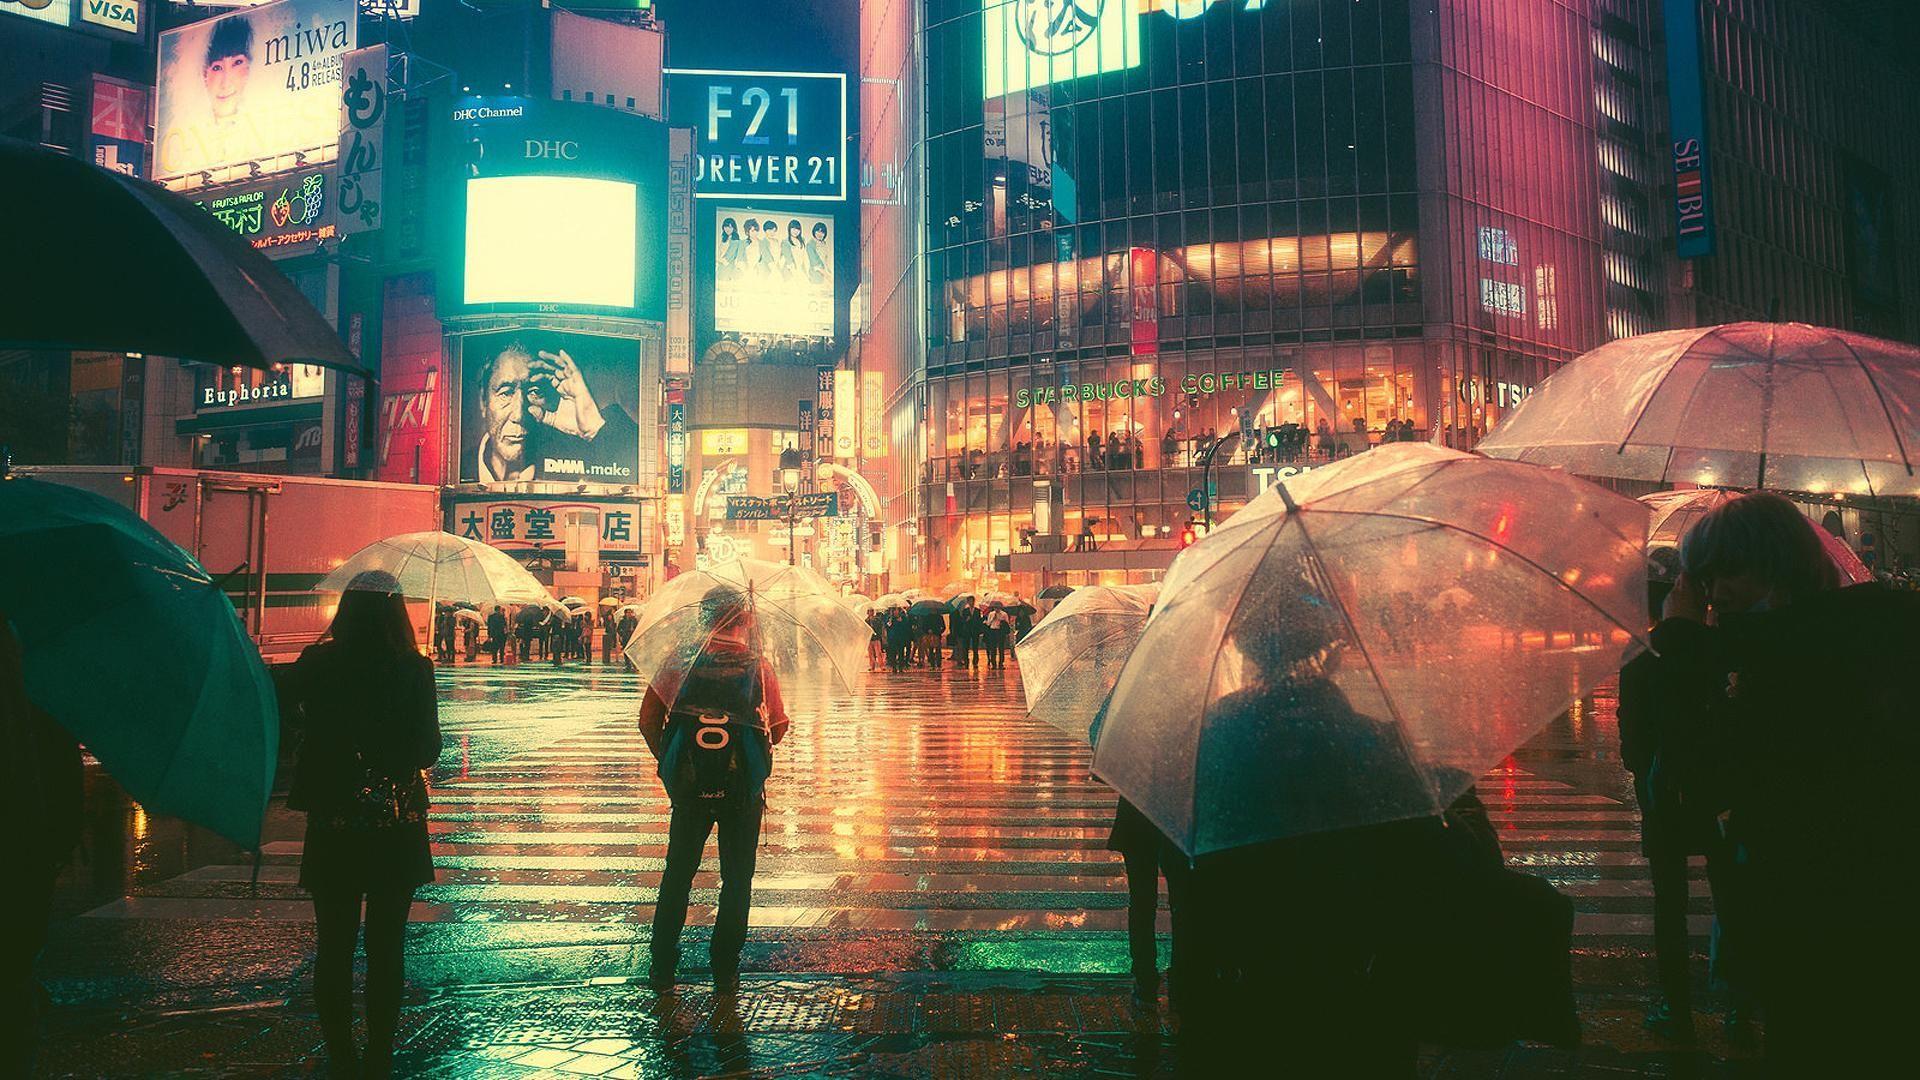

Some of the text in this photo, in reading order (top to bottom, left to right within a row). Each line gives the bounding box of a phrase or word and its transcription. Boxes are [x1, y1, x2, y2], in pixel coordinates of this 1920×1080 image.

[89, 0, 136, 24] VISA
[265, 20, 348, 66] miwa
[286, 62, 310, 91] 4.8
[322, 53, 344, 69] ALBU
[312, 67, 342, 87] RELEAS
[454, 106, 523, 120] DHC Channel
[708, 86, 798, 145] F21
[341, 66, 384, 227] もんじゃ
[525, 140, 578, 160] DHC
[808, 156, 835, 184] 21
[1674, 138, 1704, 234] SEIBU
[539, 304, 559, 312] DHC
[204, 380, 288, 407] Euphoria
[1016, 370, 1284, 408] STARBUCKS COFFEE
[819, 370, 833, 457] 洋服の青山
[671, 409, 682, 488] 大盛堂ビル
[544, 458, 630, 477] DMM.make
[461, 508, 632, 542] 大盛堂店
